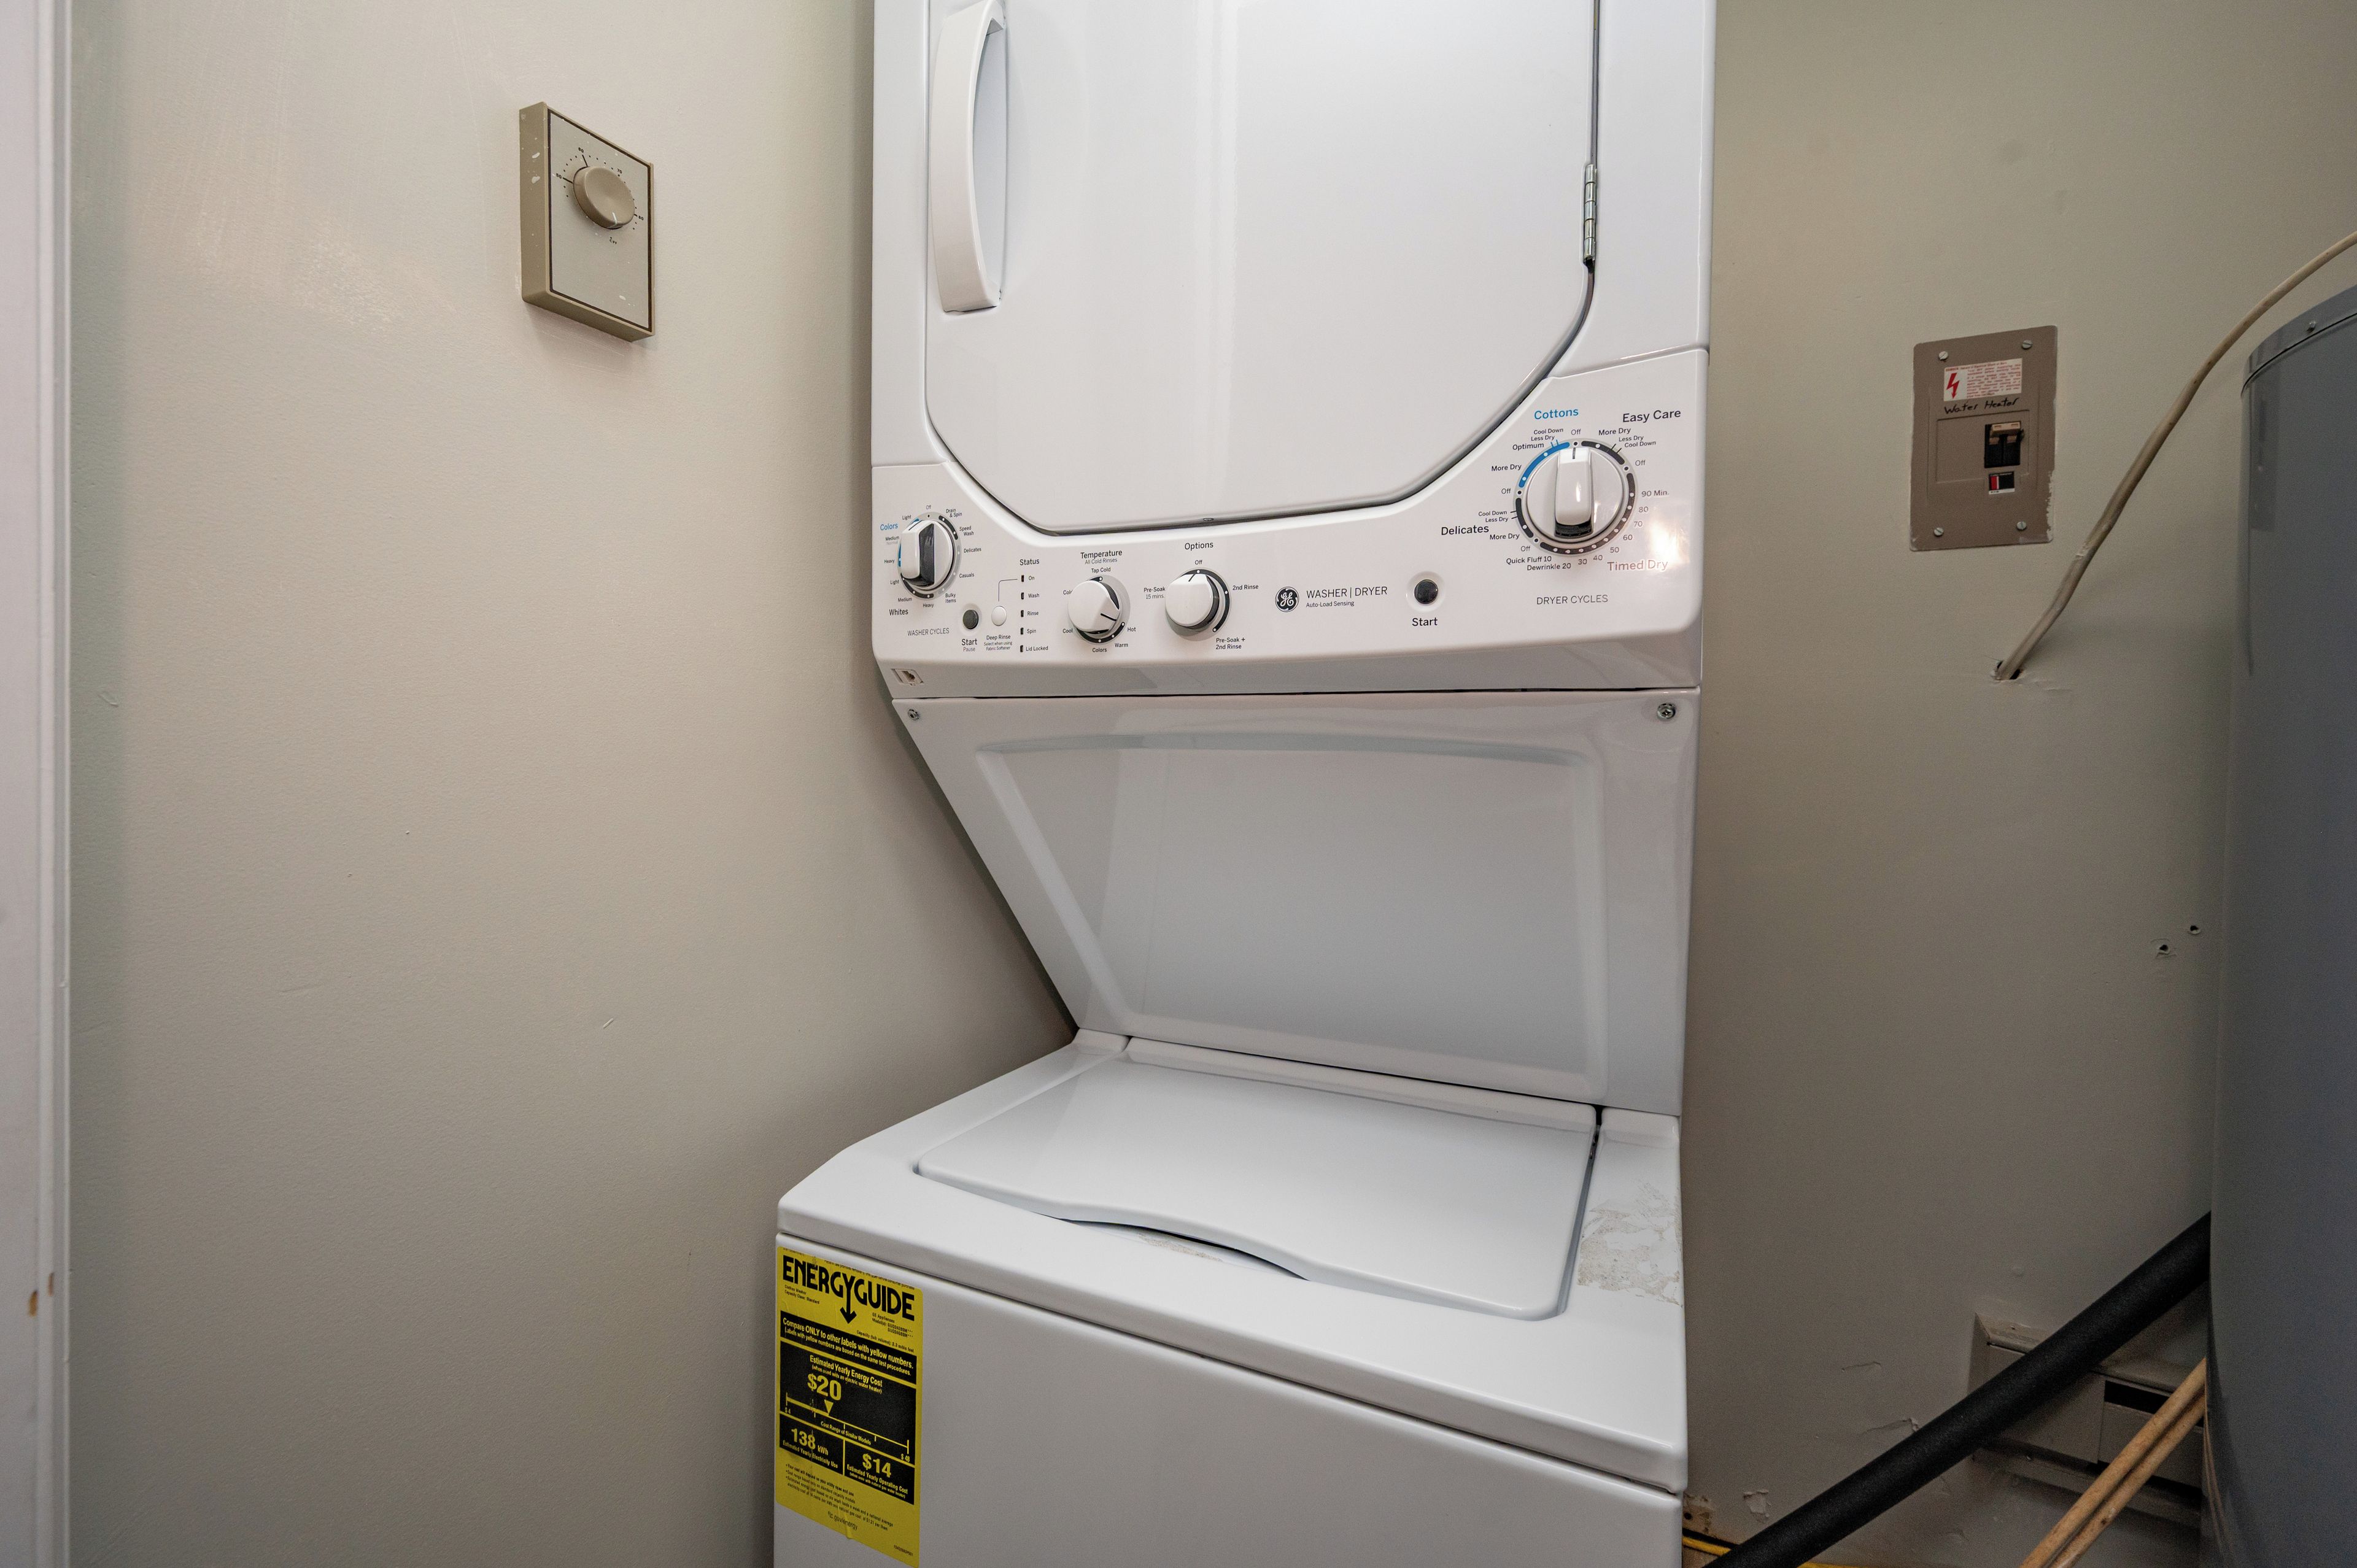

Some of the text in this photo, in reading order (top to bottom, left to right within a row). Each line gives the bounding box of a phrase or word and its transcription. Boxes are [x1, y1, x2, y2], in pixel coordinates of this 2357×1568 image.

[1535, 409, 1578, 419] Cottons
[1945, 402, 1978, 414] Water
[1623, 410, 1681, 423] Easy Care
[1442, 525, 1489, 535] Delicates
[1185, 542, 1213, 551] Options
[1080, 550, 1122, 559] Temperature
[1607, 560, 1668, 571] Timed Dry
[1306, 586, 1387, 599] WASHER DRYER
[1537, 595, 1608, 605] DRYER CYCLES
[1412, 617, 1438, 626] Start
[783, 1255, 915, 1321] ENERGYGUIDE
[783, 1318, 804, 1331] Compare
[805, 1326, 820, 1336] ONLY
[827, 1334, 840, 1343] other
[841, 1337, 857, 1349] labels
[858, 1344, 869, 1353] with
[870, 1348, 887, 1359] yellow
[888, 1355, 914, 1369] numbers.
[785, 1326, 797, 1336] Labels
[818, 1340, 834, 1349] numbers
[842, 1347, 854, 1356] based
[810, 1355, 883, 1387] Estimated Yearly Energy Cost
[807, 1373, 841, 1400] $20
[791, 1428, 828, 1455] 138 kWh
[862, 1453, 892, 1478] $14
